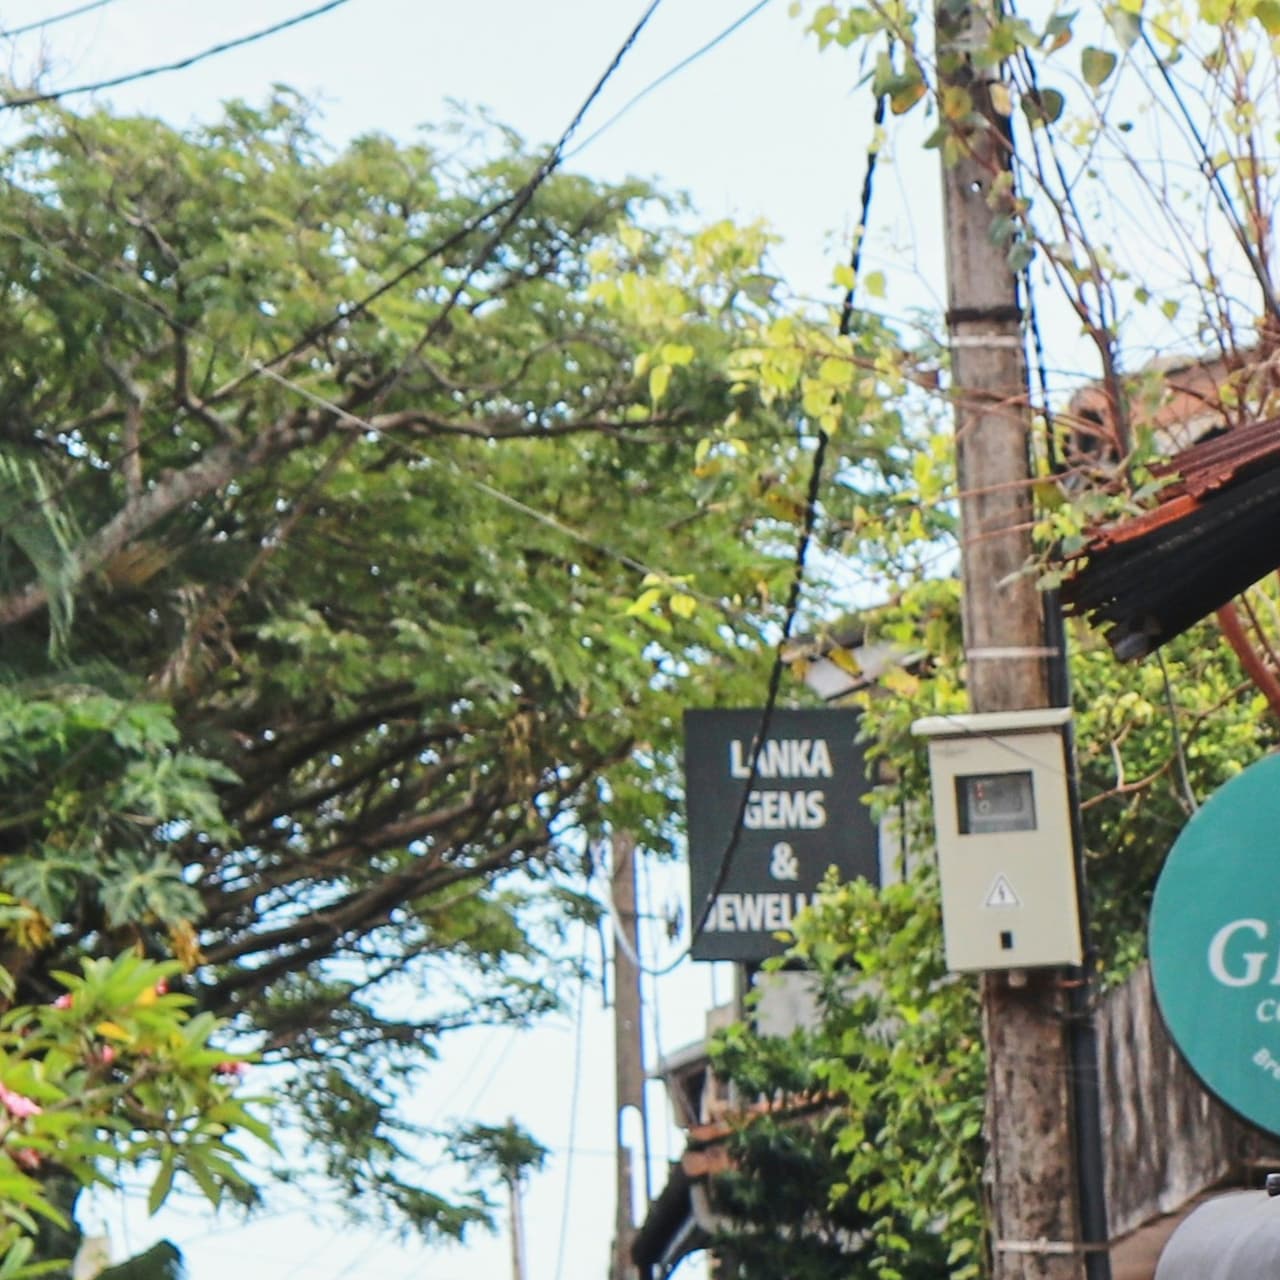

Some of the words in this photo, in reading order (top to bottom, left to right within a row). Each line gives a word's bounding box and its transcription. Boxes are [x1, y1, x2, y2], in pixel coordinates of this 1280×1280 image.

[730, 739, 833, 778] LANKA
[743, 789, 827, 829] GEMS
[769, 841, 799, 880] &
